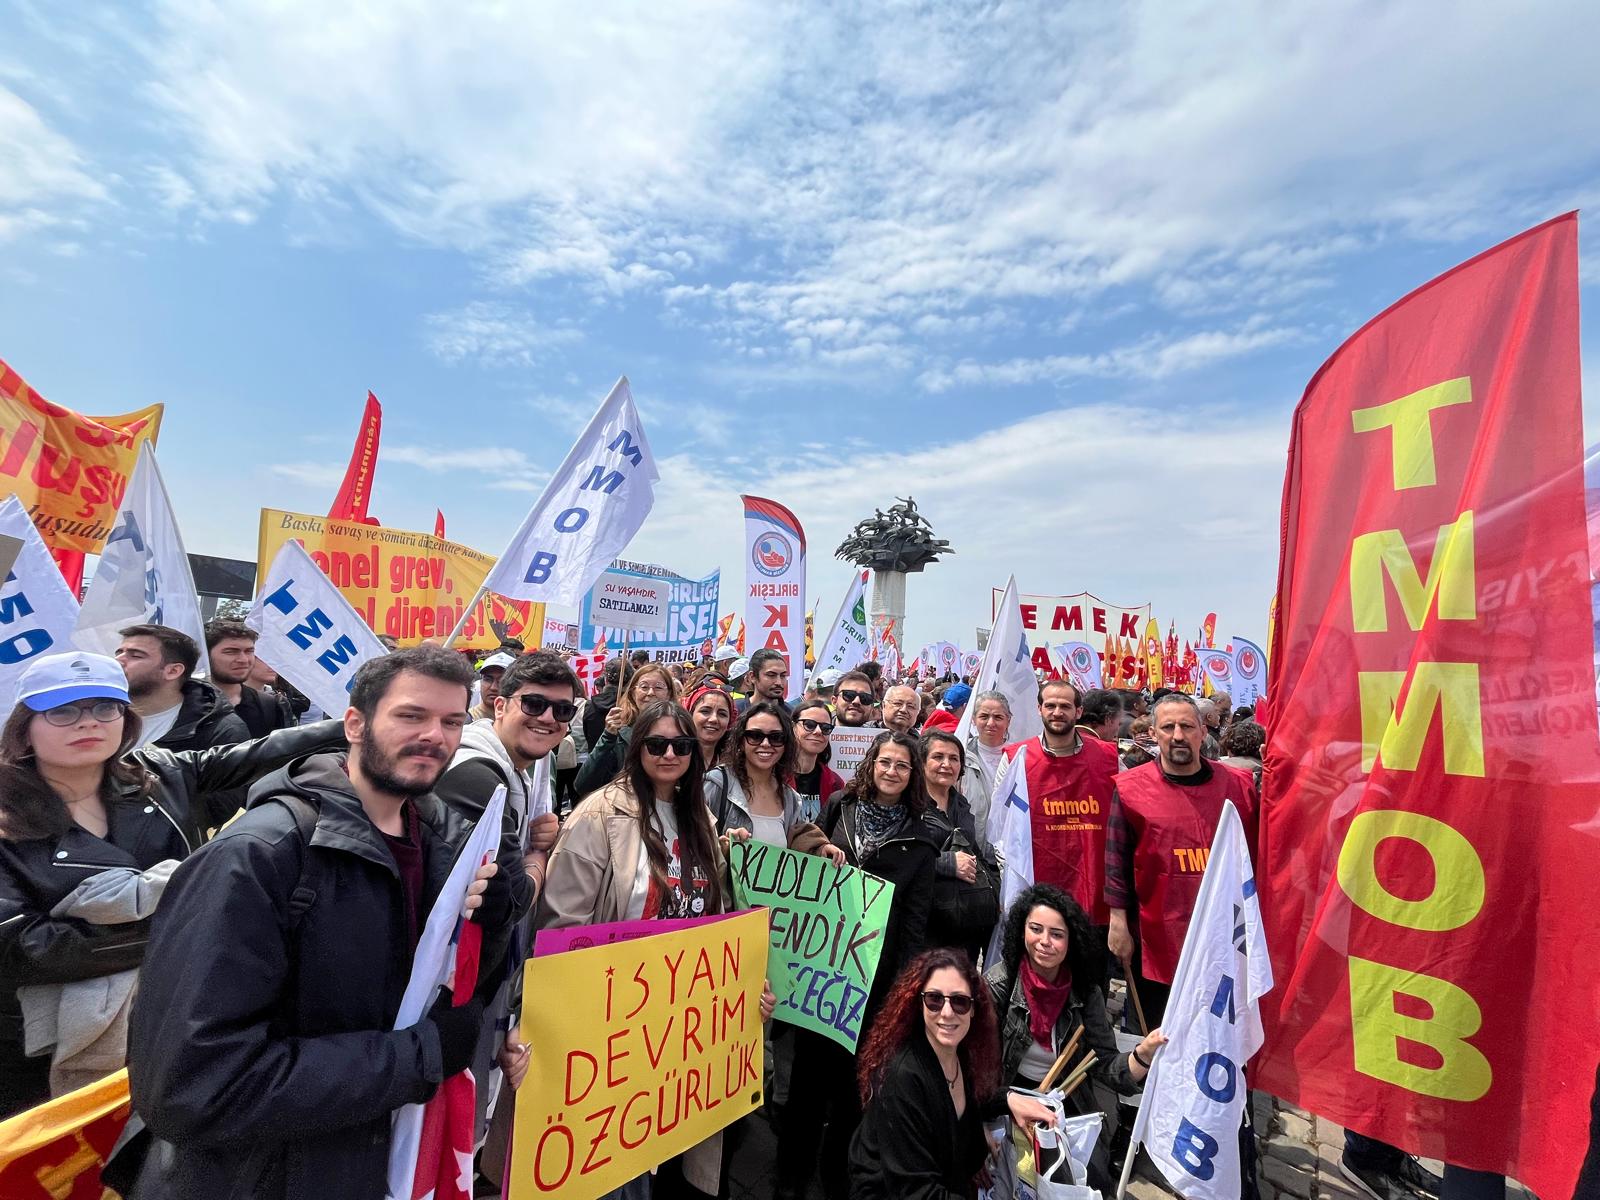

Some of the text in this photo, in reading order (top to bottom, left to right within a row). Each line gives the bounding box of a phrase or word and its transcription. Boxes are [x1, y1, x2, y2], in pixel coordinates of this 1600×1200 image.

[280, 514, 324, 535] Baskı,
[328, 523, 363, 541] savaş
[366, 529, 378, 541] ve
[296, 539, 453, 594] enel grev,
[263, 578, 358, 695] TMM
[655, 646, 698, 663] BİRLİĞİ
[841, 619, 866, 645] TARIM
[1020, 604, 1139, 639] EMEK
[1338, 376, 1493, 1101] TMMOB
[1043, 796, 1100, 815] tmmob
[605, 937, 740, 1022] İSYAN
[769, 905, 881, 986] ENDİK
[565, 991, 745, 1106] DEVRİM
[533, 1039, 758, 1192] ÖZGÜRLÜK
